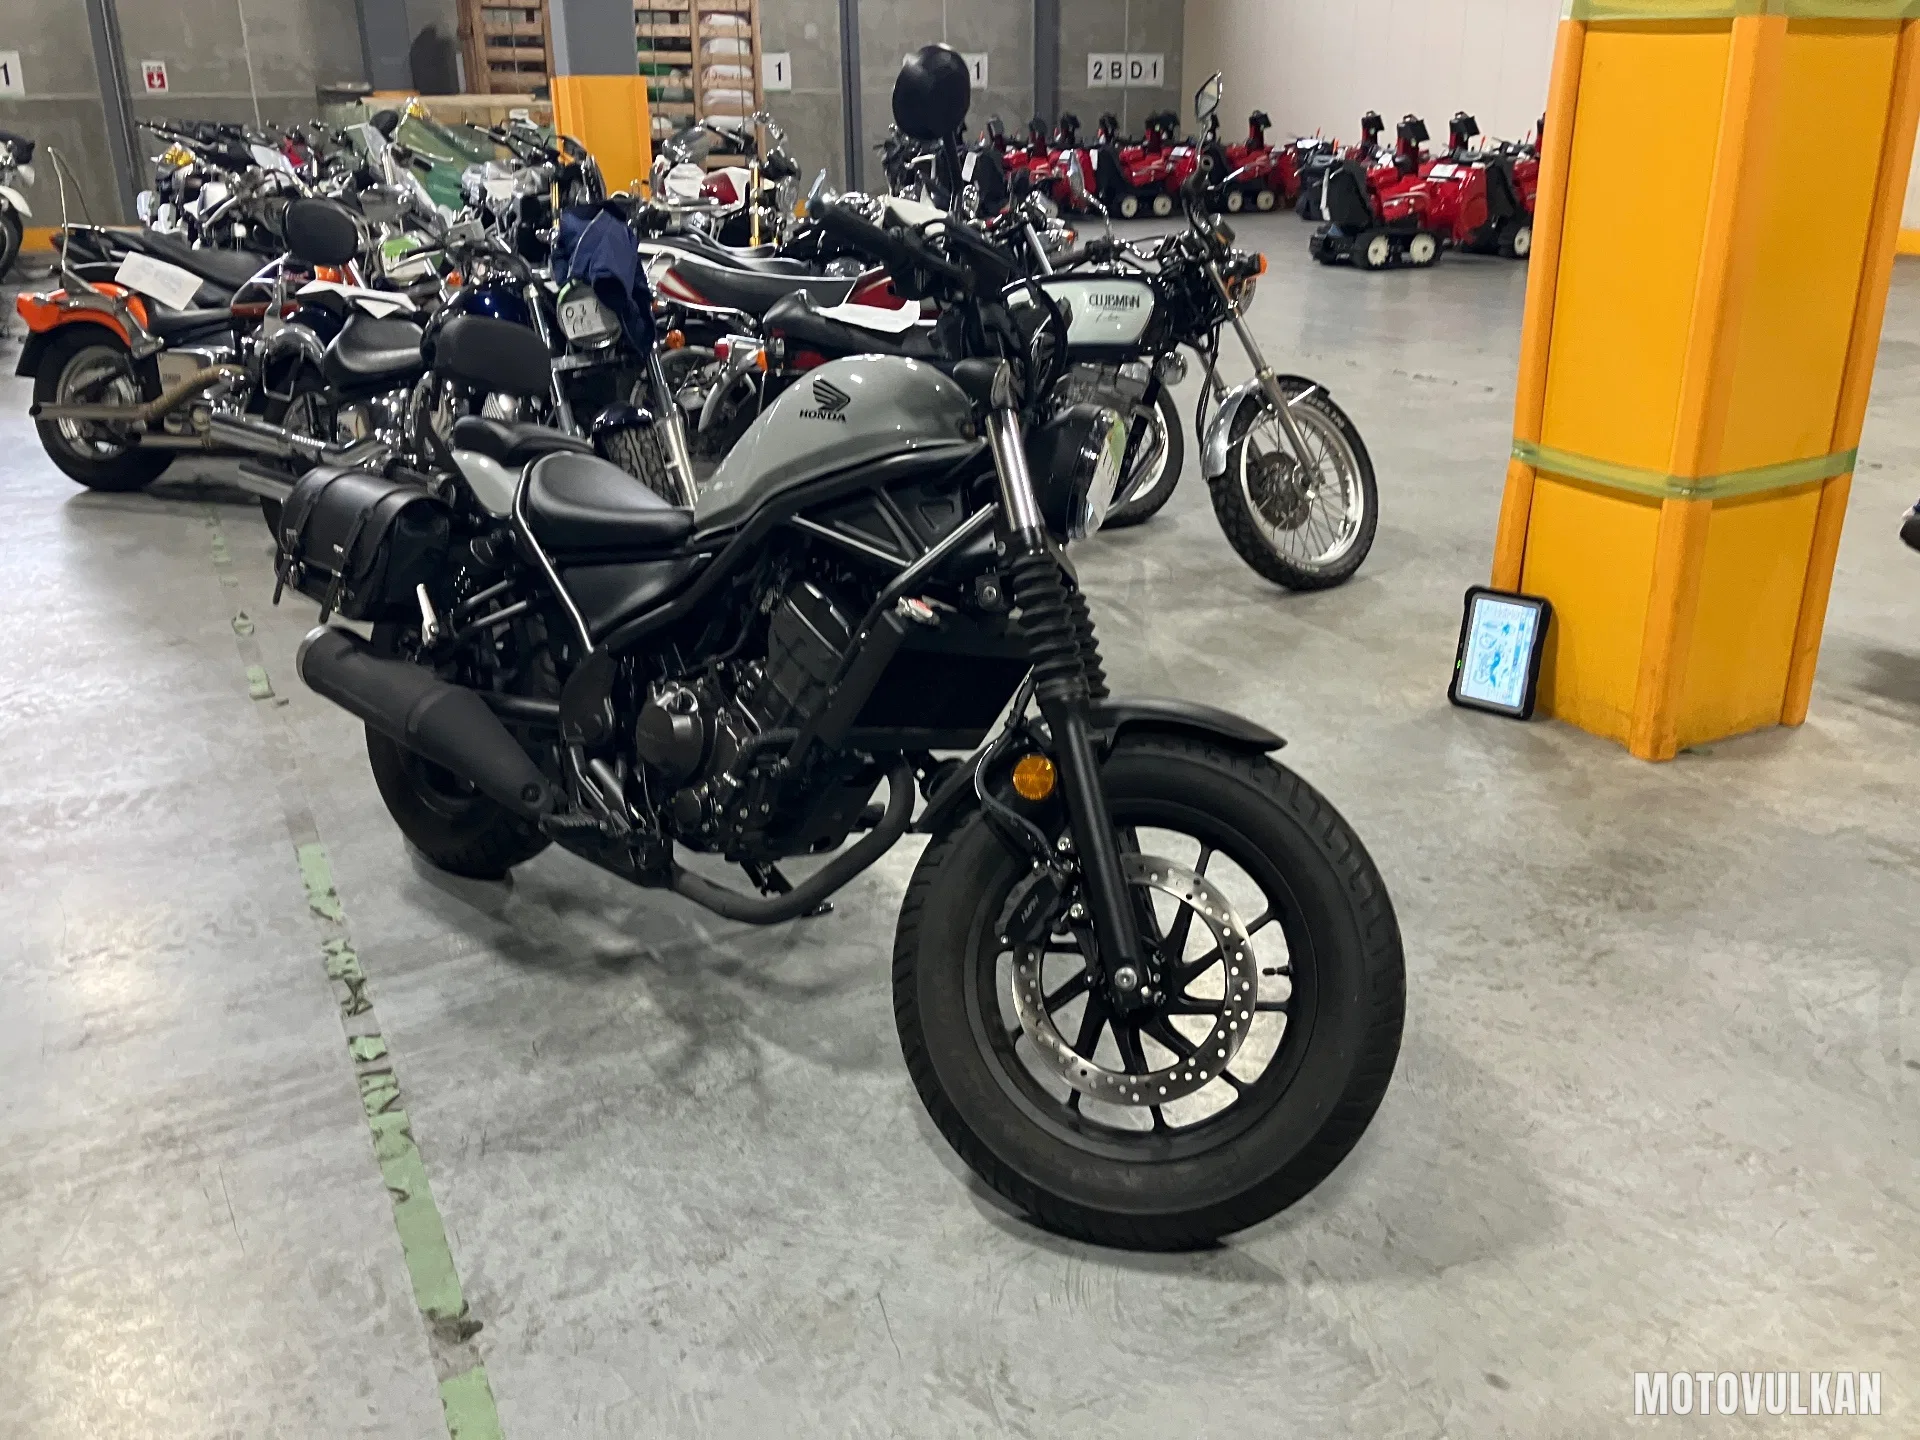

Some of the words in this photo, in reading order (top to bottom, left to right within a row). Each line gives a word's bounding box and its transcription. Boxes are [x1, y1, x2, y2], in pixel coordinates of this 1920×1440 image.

[775, 61, 782, 82] 1
[1089, 294, 1140, 309] CLUBMAN
[799, 408, 847, 423] HONDA
